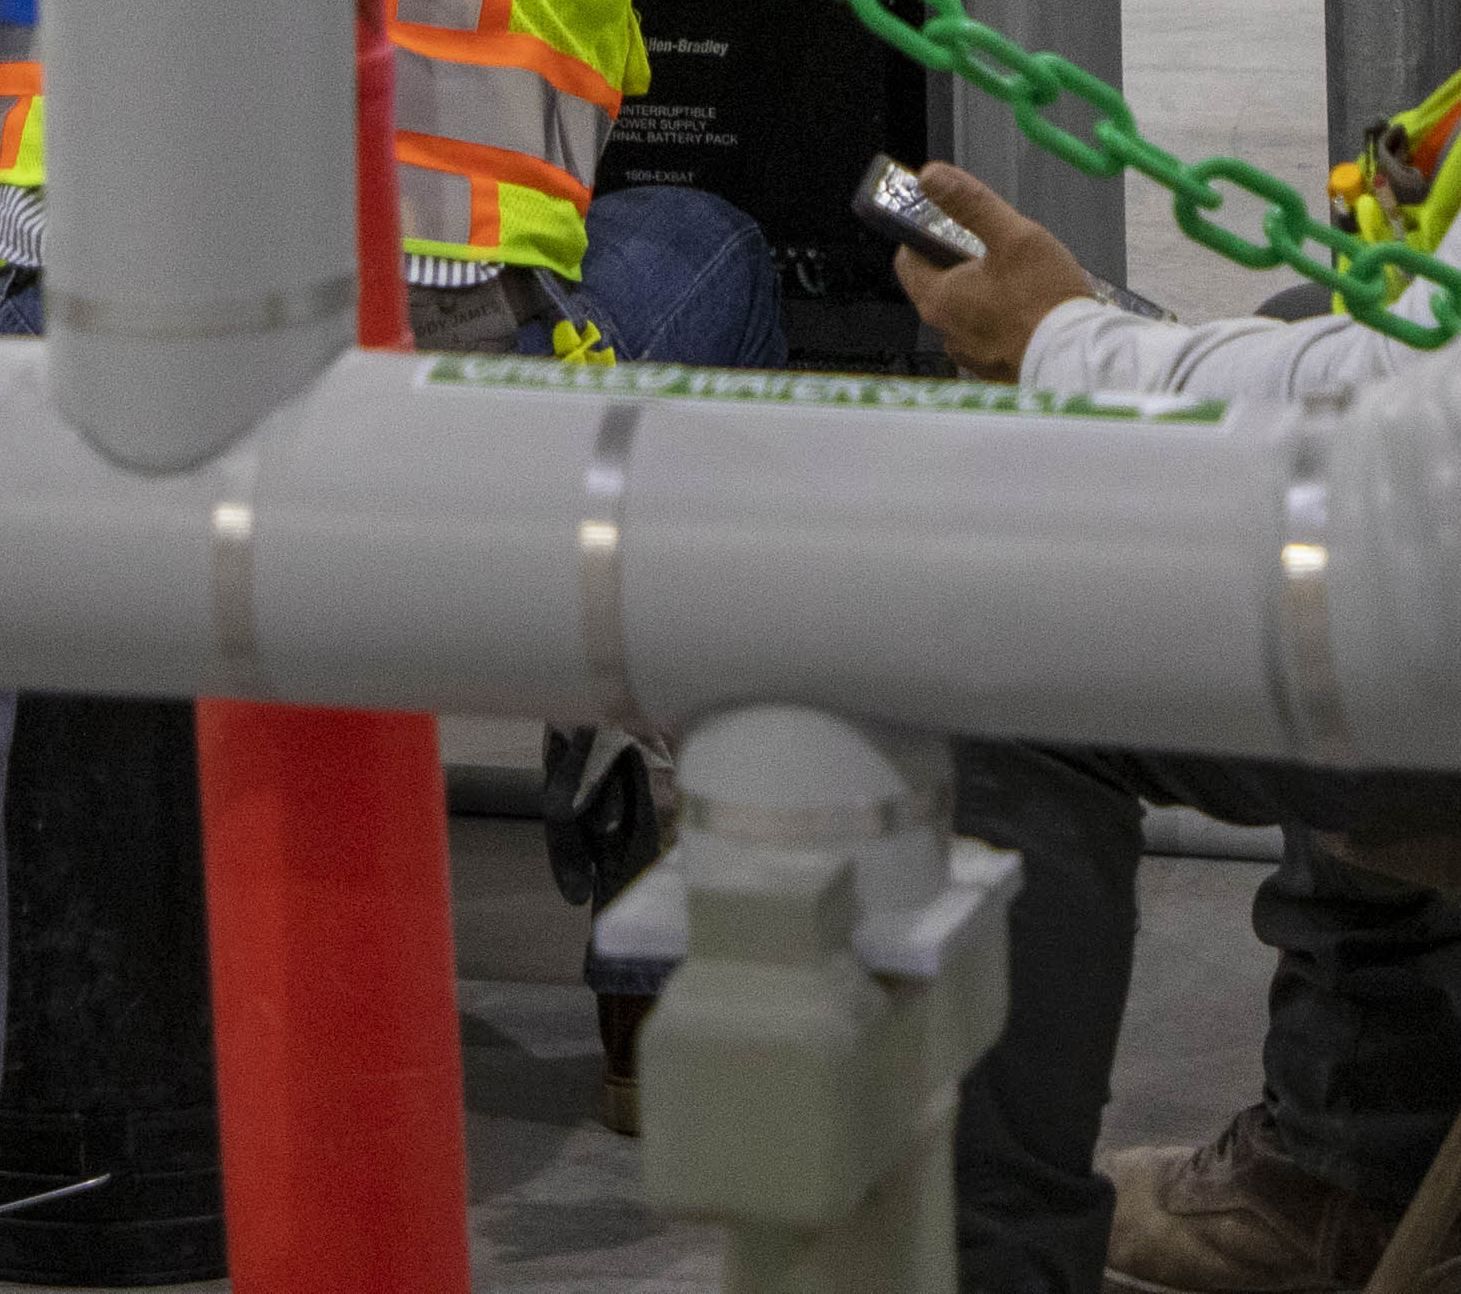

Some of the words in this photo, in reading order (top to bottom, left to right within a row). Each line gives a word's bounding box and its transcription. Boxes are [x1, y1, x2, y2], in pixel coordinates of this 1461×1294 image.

[645, 38, 729, 57] llen-Bradley
[619, 105, 717, 118] INTERRUPTIBLE
[659, 119, 707, 132] SUPPLY
[647, 131, 703, 144] BATTERY
[705, 132, 739, 146] PACK
